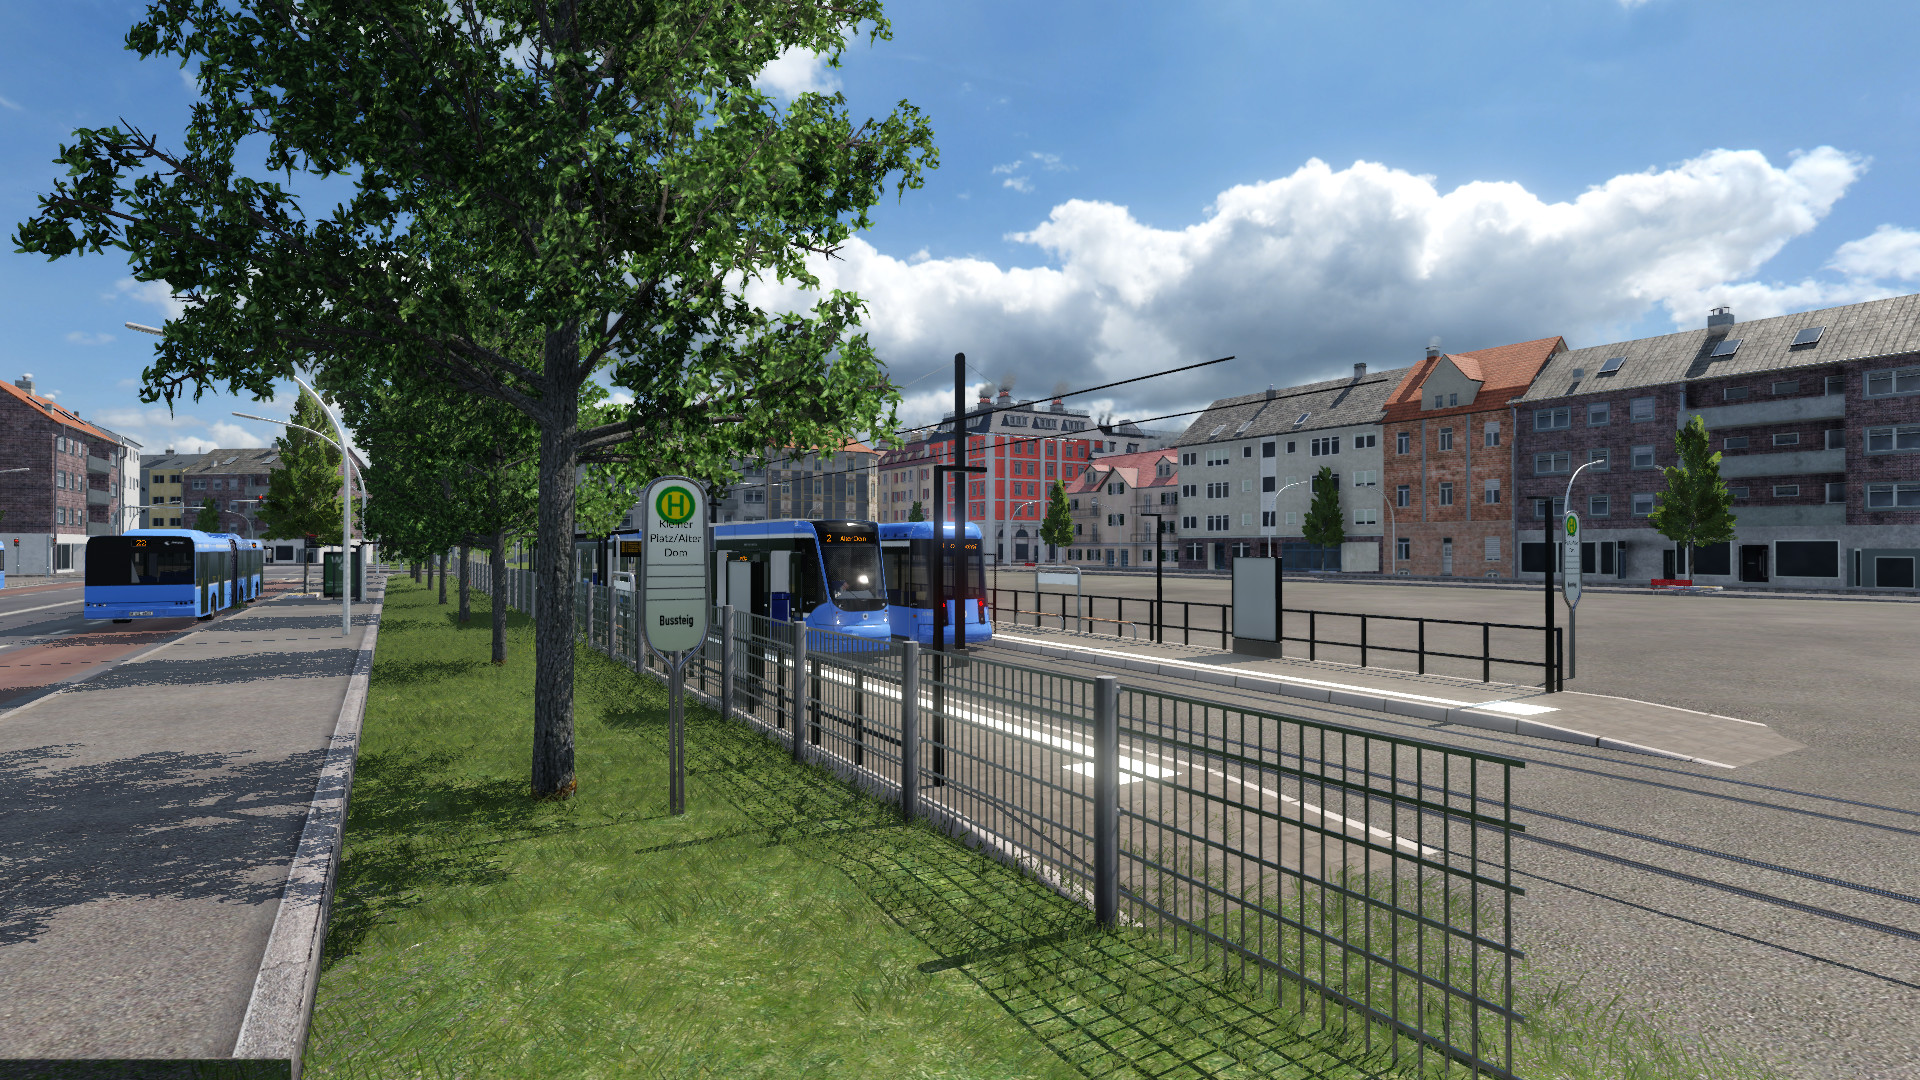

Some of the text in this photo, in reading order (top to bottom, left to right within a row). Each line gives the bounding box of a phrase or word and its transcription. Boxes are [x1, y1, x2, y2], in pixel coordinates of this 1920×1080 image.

[668, 494, 684, 516] H
[659, 519, 694, 529] Kleiner
[650, 533, 702, 543] Platz/Alter
[826, 533, 832, 543] 2
[664, 548, 688, 557] Dom
[659, 615, 694, 628] Bussteig
